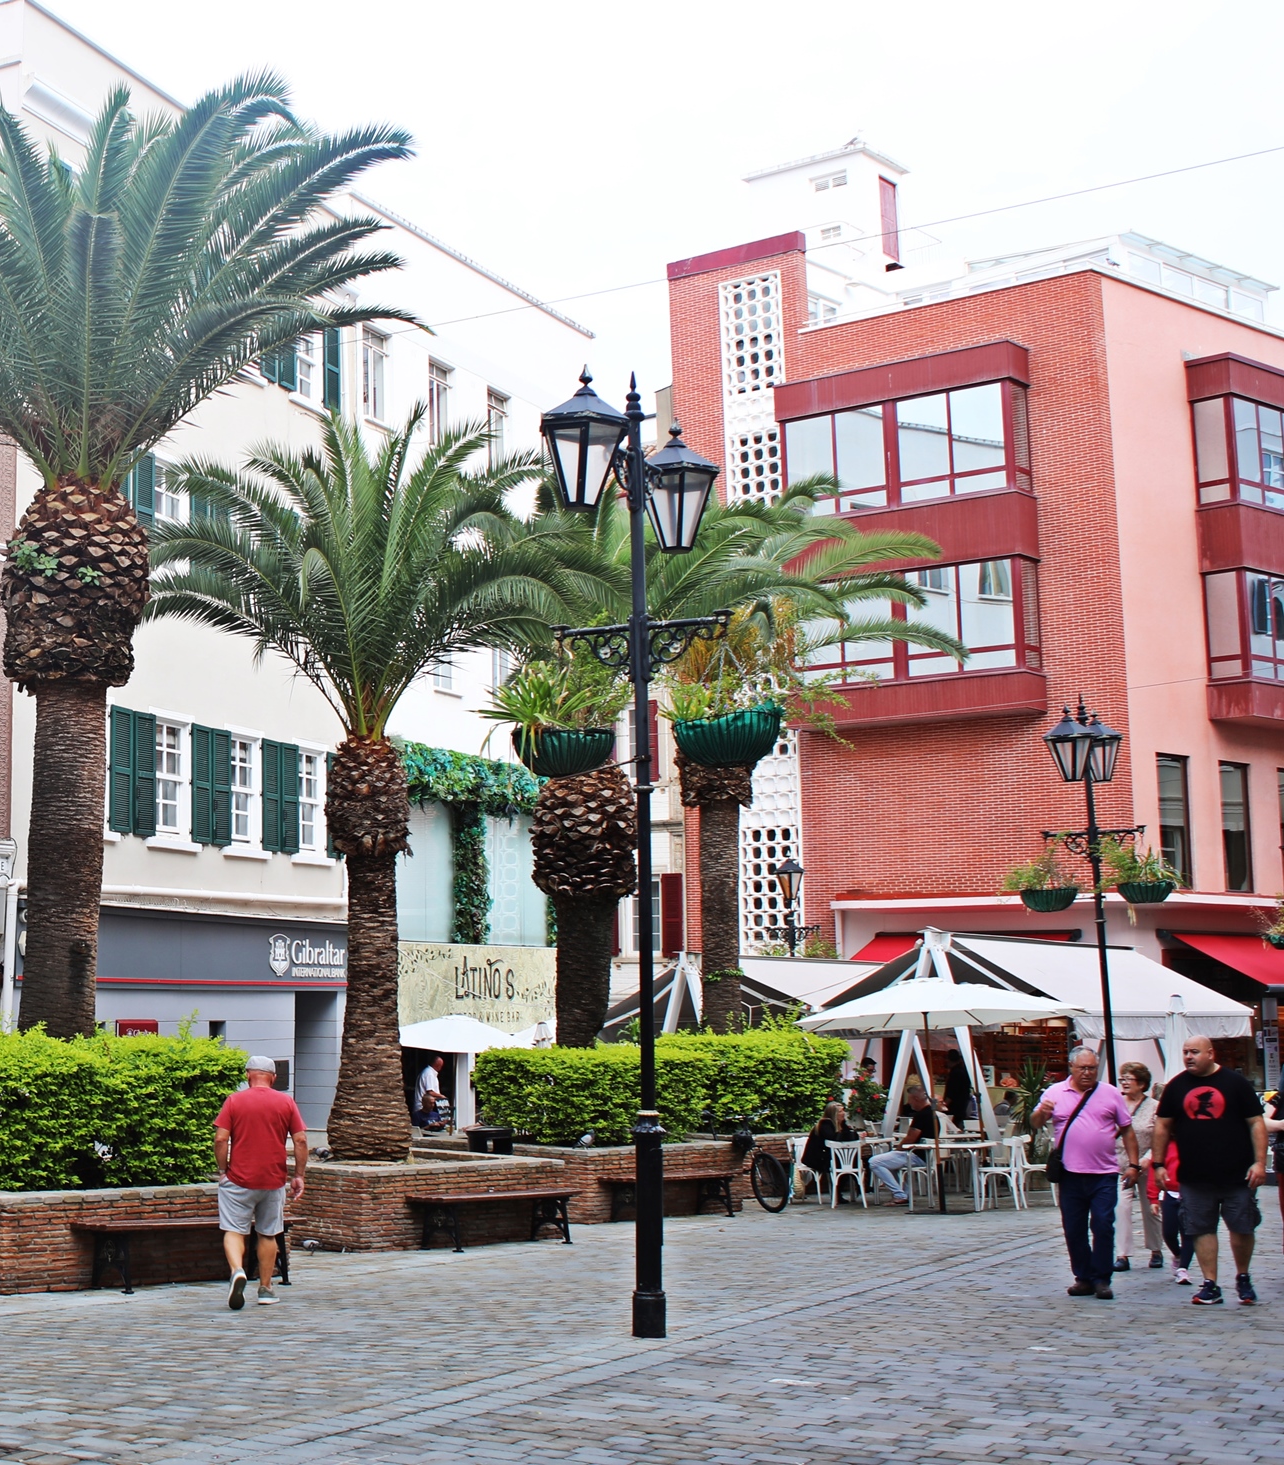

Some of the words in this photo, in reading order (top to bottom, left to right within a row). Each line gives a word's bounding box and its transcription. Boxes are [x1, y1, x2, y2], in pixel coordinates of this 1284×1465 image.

[291, 939, 346, 966] Gibraltar
[292, 967, 330, 978] INTERNATIONAL
[330, 968, 346, 978] BANK
[485, 1012, 504, 1023] WINE
[506, 1011, 520, 1023] BAR
